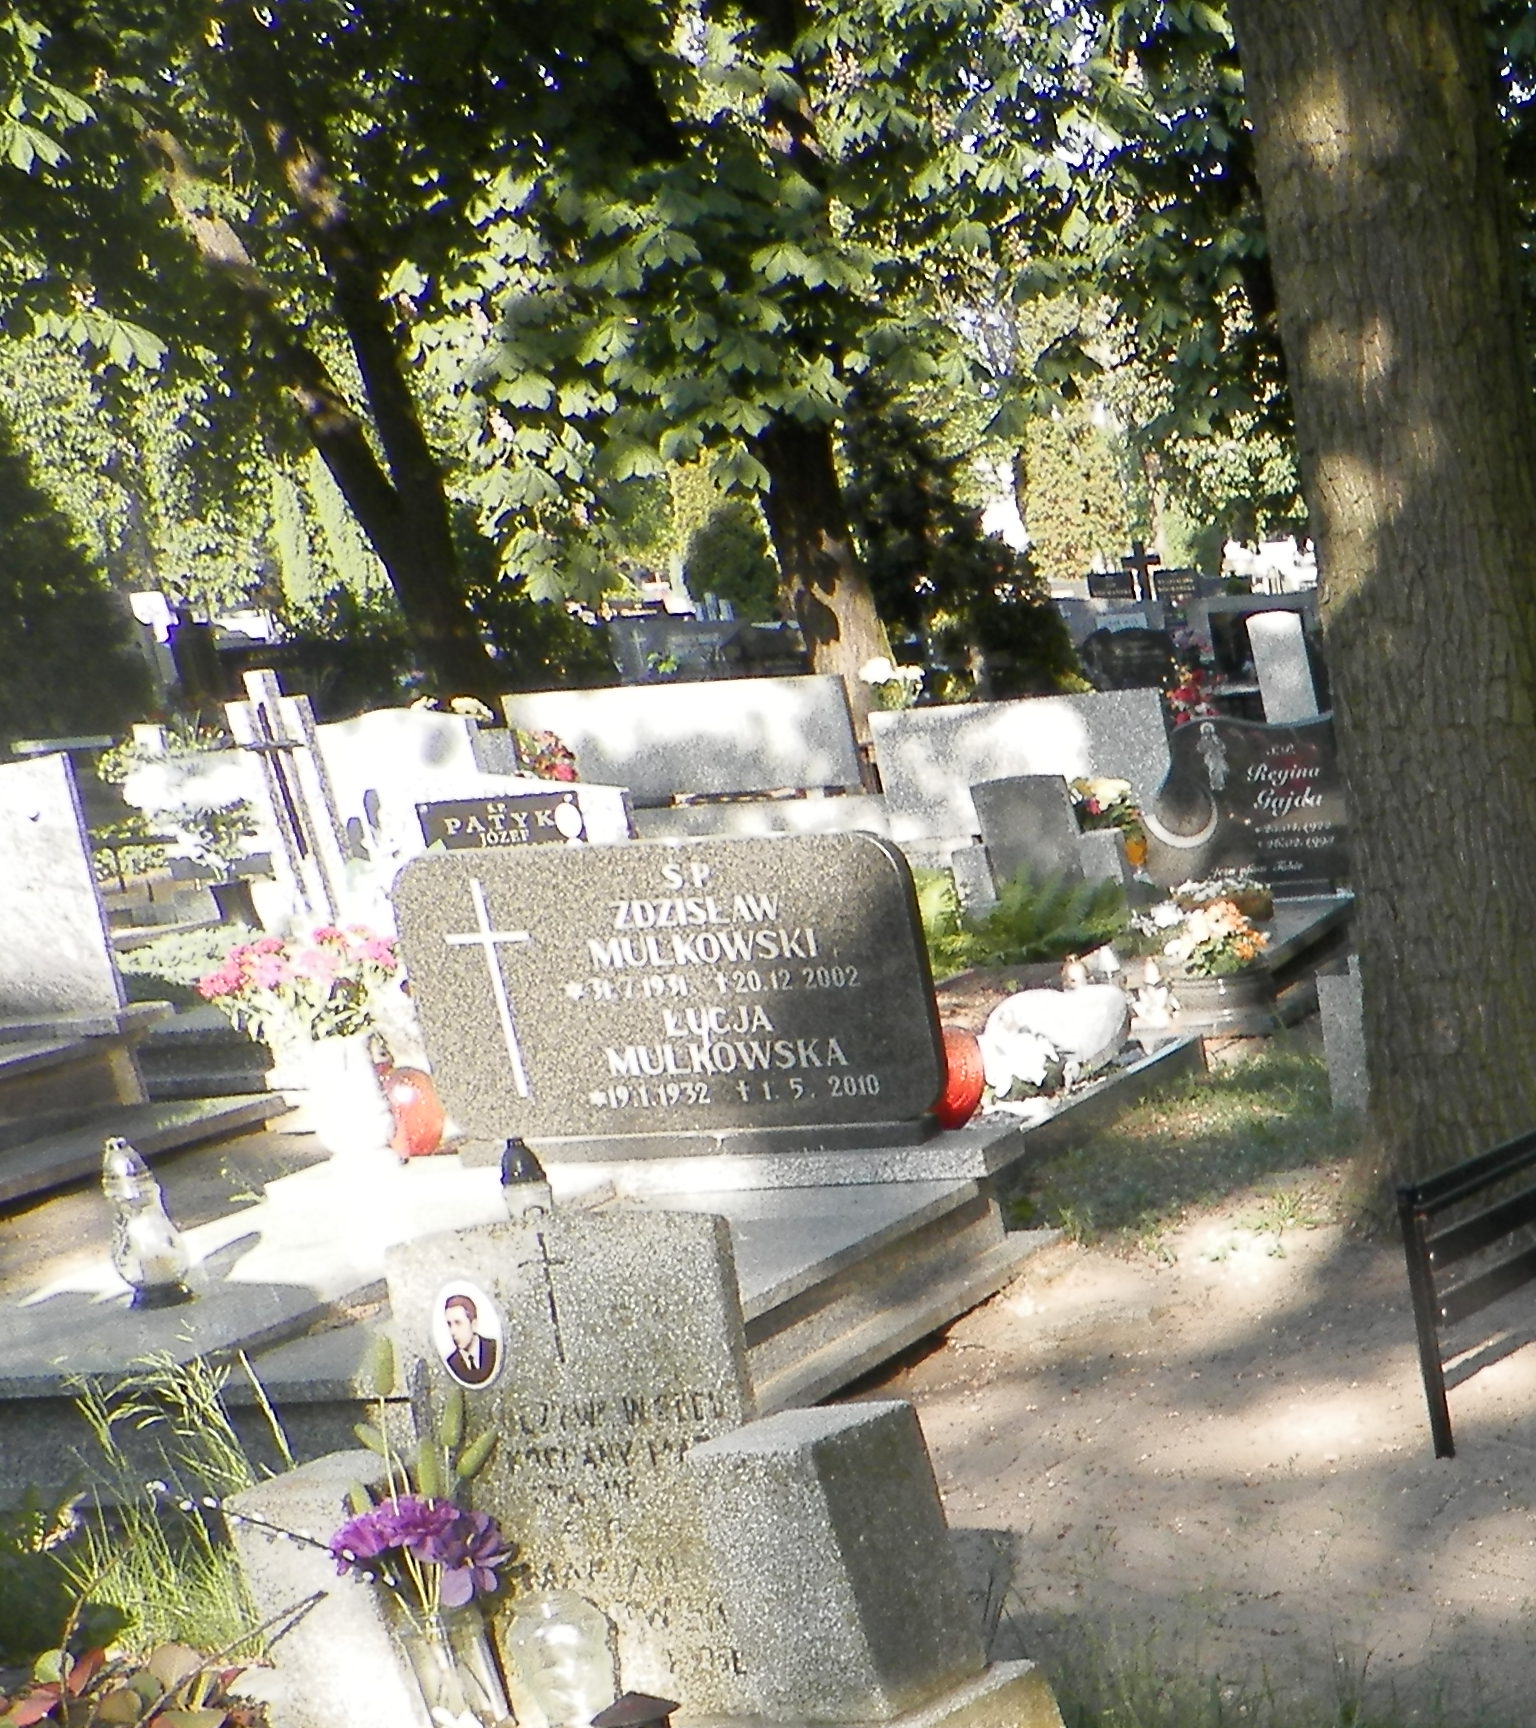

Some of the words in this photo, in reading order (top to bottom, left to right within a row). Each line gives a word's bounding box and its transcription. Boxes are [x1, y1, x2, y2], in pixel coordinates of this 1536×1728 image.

[1247, 763, 1321, 787] Regina
[1254, 786, 1323, 817] Gajda
[444, 810, 555, 835] PATYK
[610, 893, 780, 931] ZDZISŁAW
[587, 927, 820, 971] MULKOWSKI
[662, 1004, 774, 1037] ŁUCJA
[605, 1038, 849, 1078] MULKOWSKA
